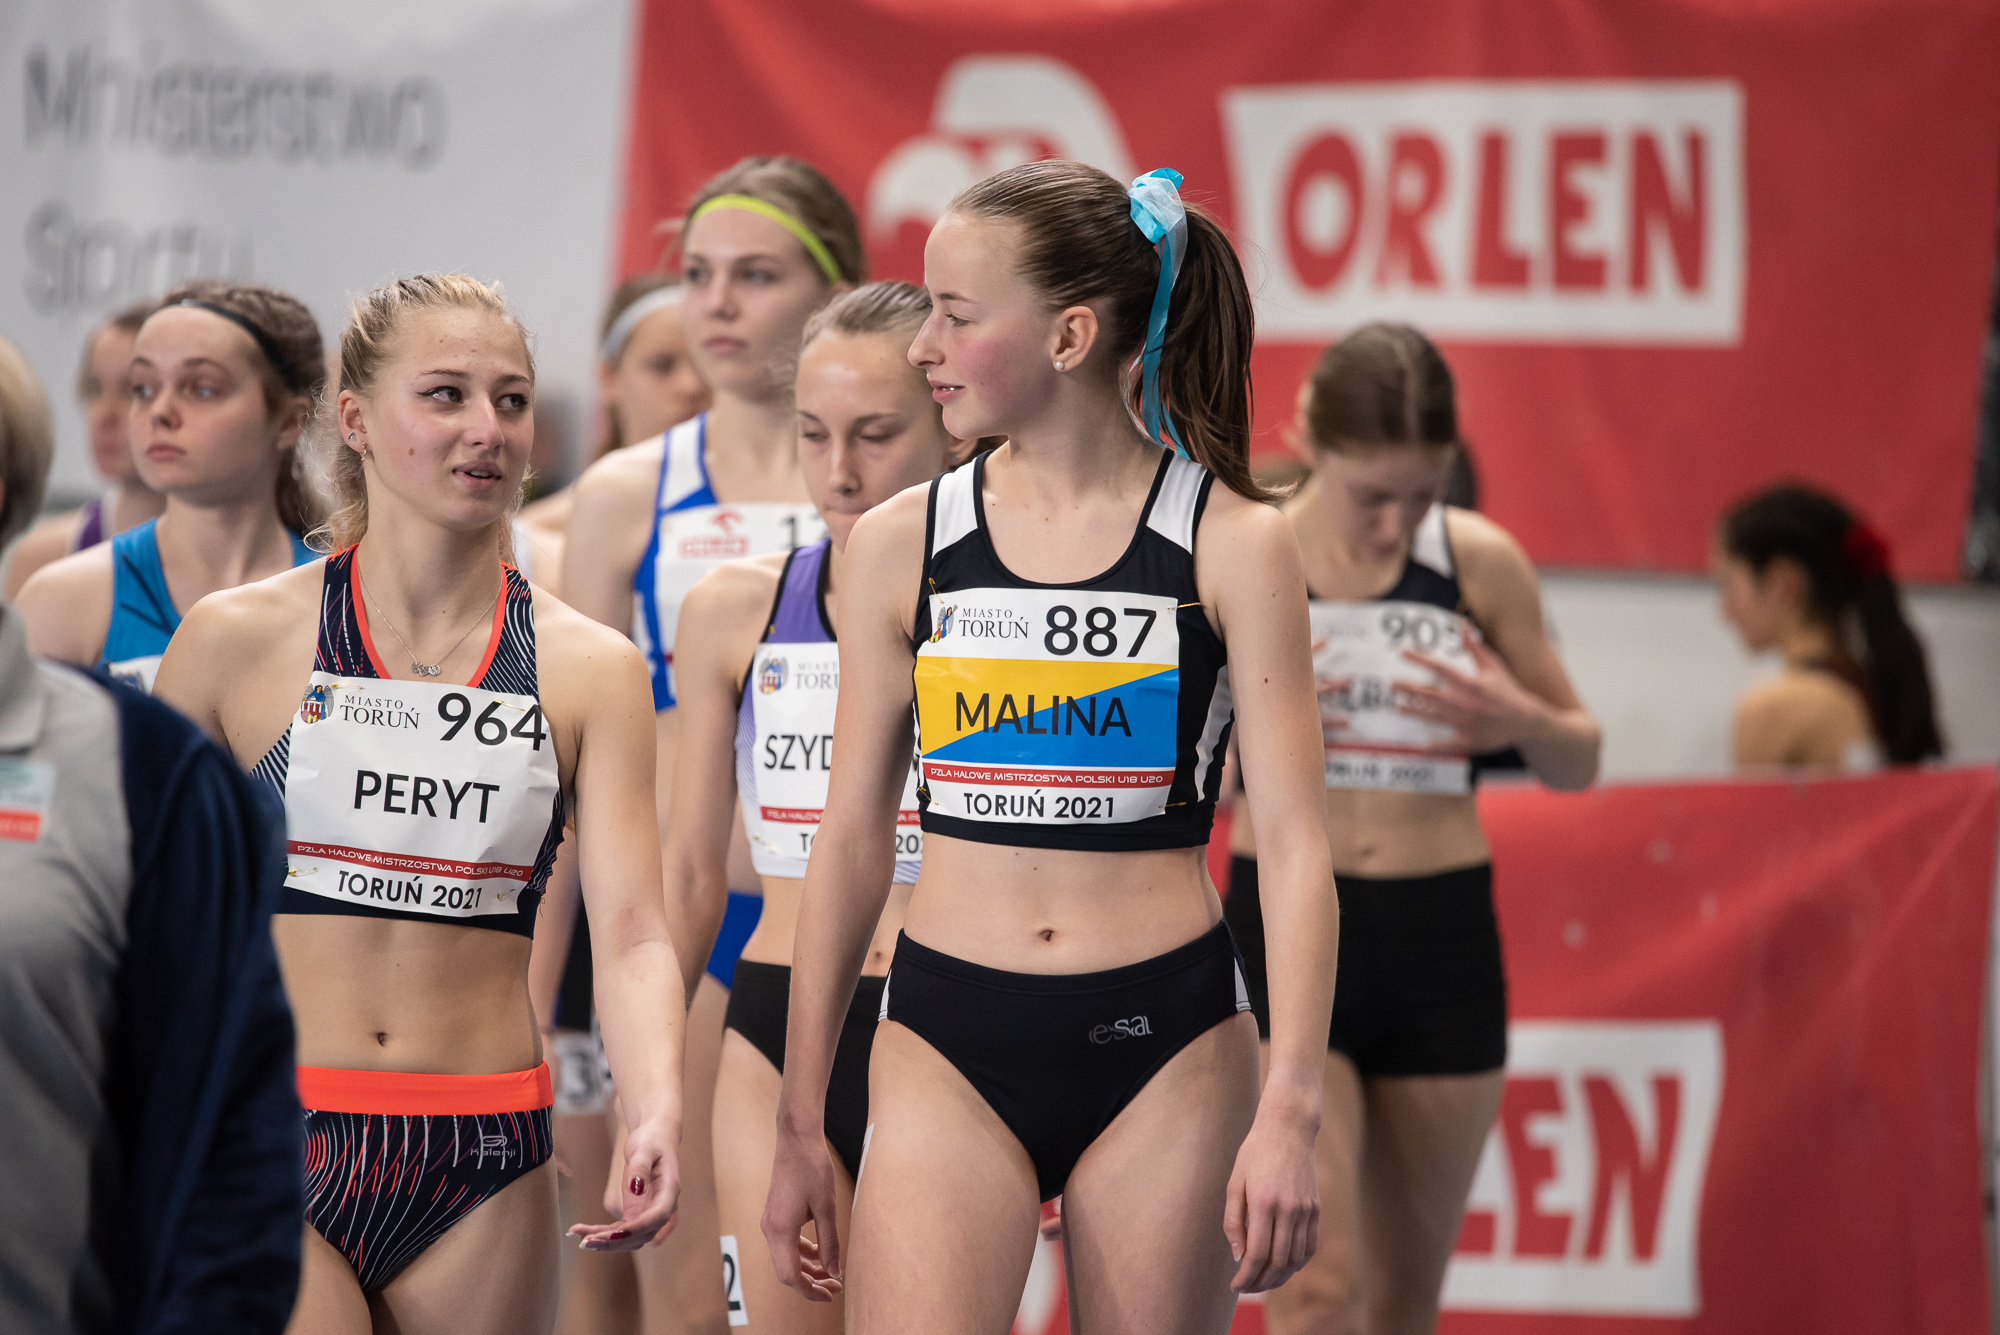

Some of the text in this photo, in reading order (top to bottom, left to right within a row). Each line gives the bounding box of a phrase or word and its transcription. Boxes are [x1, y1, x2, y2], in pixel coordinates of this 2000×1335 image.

[1284, 126, 1709, 296] ORLEN
[959, 617, 1030, 639] TORUŃ
[962, 608, 1013, 619] MIASTO
[1044, 605, 1157, 658] 887
[340, 705, 420, 729] TORUŃ
[345, 695, 403, 709] MIASTO
[956, 692, 1132, 737] MALINA
[438, 693, 546, 751] 964
[931, 768, 1163, 784] PZLA HALOWE MISTRZOSTWA POLSKI U18 U20
[354, 770, 500, 823] PERYT
[964, 789, 1114, 819] TORUŃ 2021
[297, 845, 326, 855] PZLA
[328, 848, 371, 861] HALOWE
[372, 855, 453, 873] MISTRZOSTWA
[455, 865, 488, 876] POLSKI
[504, 867, 524, 877] U20
[338, 870, 482, 909] TORUŃ 2021
[470, 1148, 516, 1158] Kalenji
